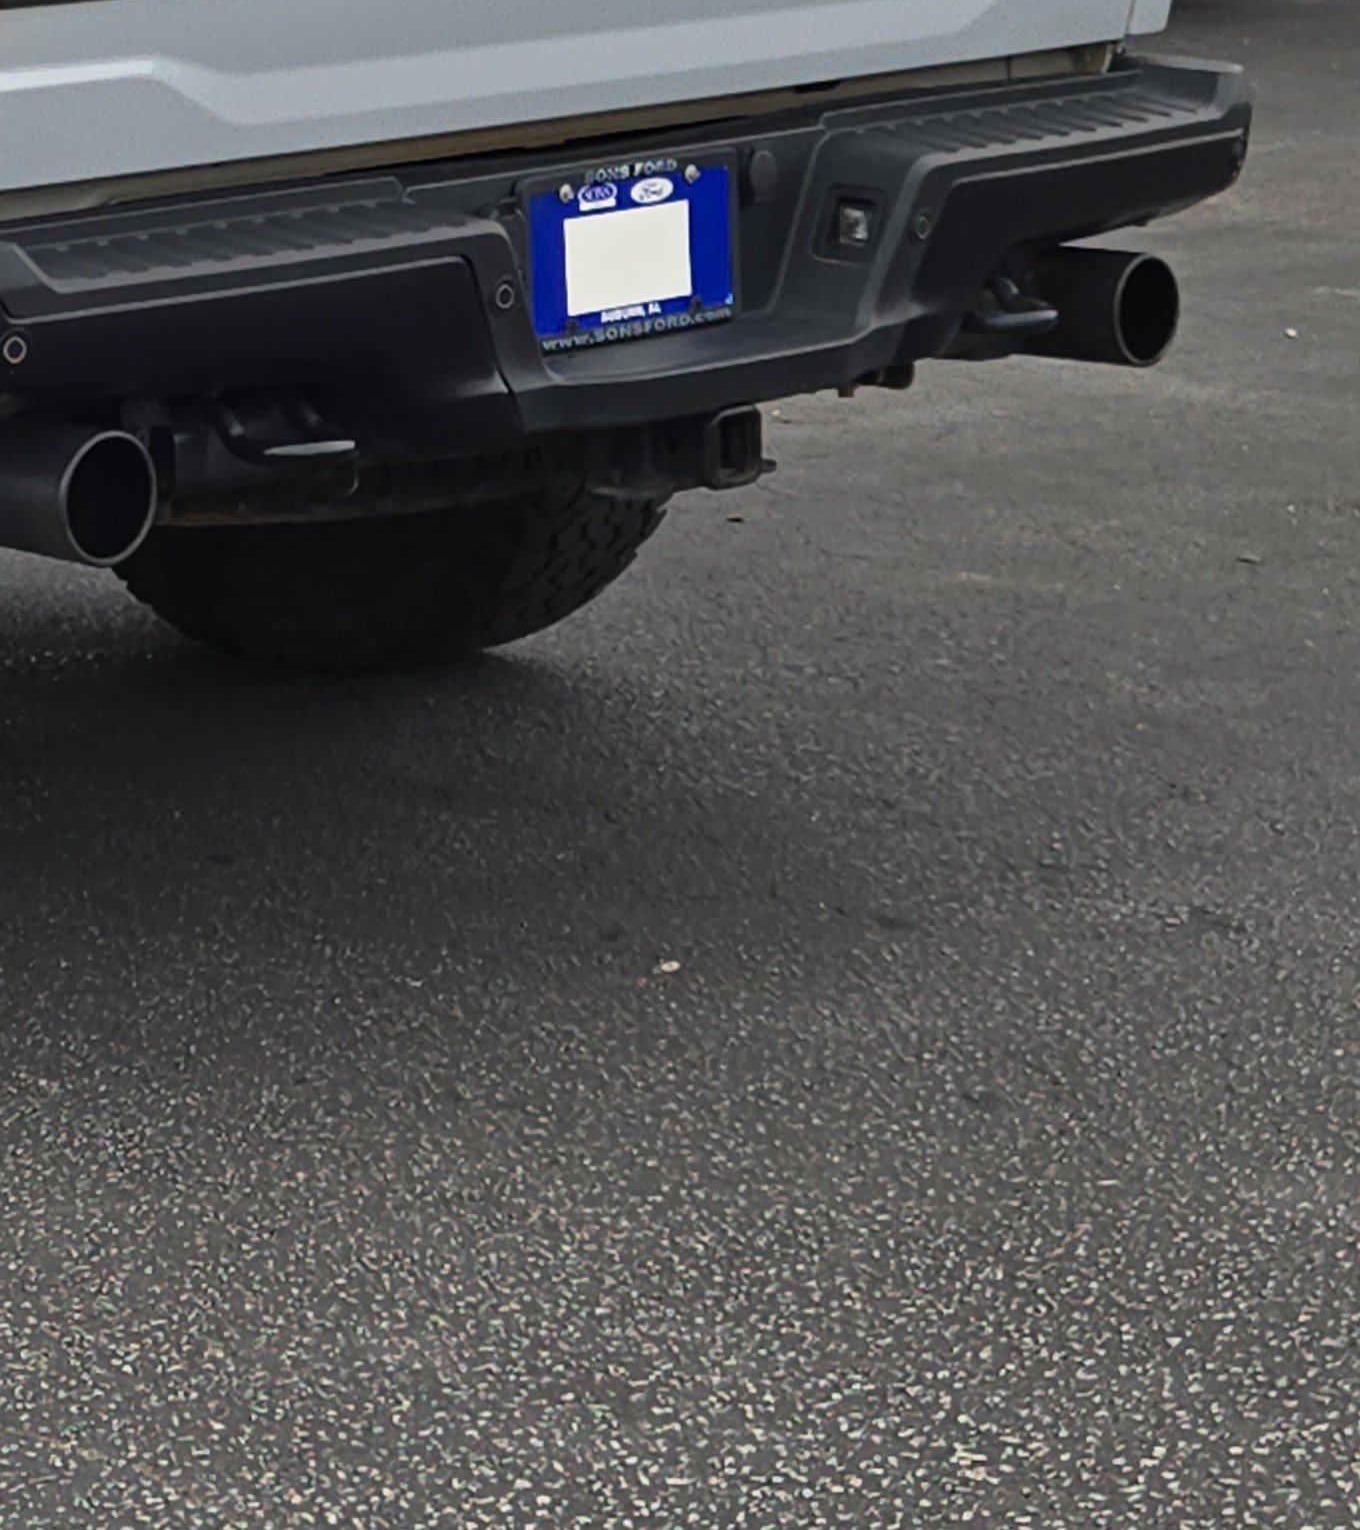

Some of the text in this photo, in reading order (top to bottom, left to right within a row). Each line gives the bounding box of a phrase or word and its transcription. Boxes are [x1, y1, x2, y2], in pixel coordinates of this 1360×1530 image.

[584, 158, 678, 184] SONS FORD
[541, 307, 732, 351] www.SONSFORD.com
